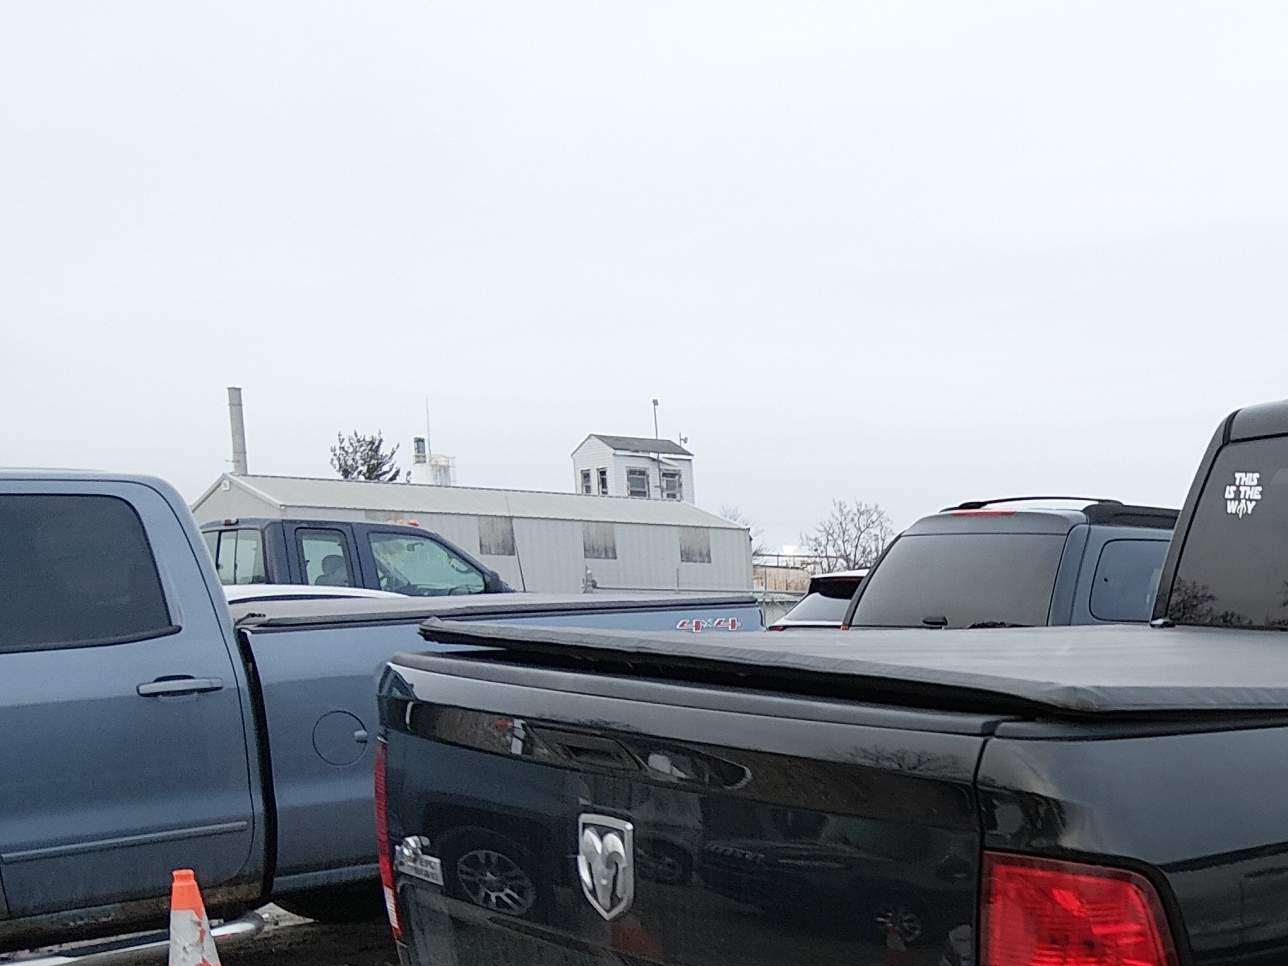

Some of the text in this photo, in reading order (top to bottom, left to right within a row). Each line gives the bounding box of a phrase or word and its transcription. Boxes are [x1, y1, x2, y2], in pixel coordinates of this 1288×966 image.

[1234, 472, 1260, 486] THIS
[1224, 485, 1263, 499] IS THE
